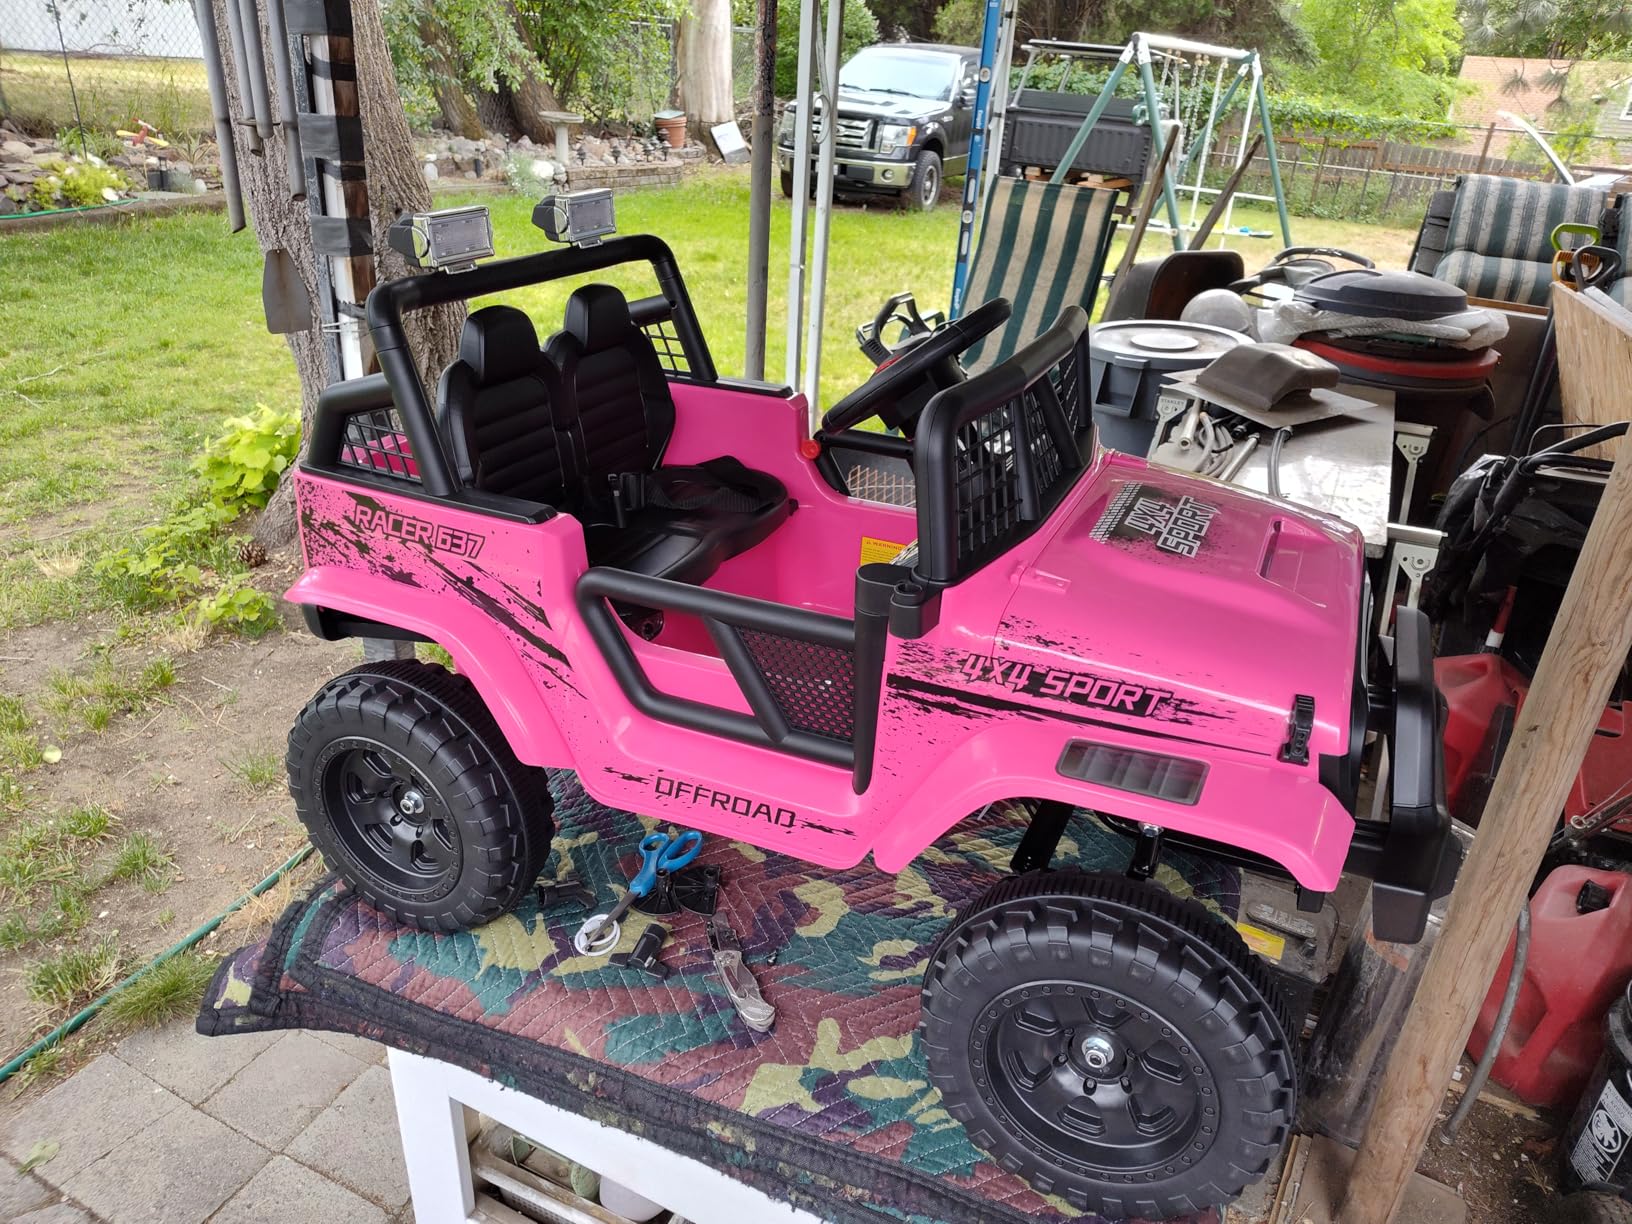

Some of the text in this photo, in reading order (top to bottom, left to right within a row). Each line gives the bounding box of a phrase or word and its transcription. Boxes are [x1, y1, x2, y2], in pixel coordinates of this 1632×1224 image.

[353, 504, 485, 559] RACER 637
[1124, 497, 1177, 536] 4X4
[1156, 495, 1221, 558] SPORT
[961, 653, 1172, 716] 4X4 SPORT
[655, 776, 796, 828] OFFROAD
